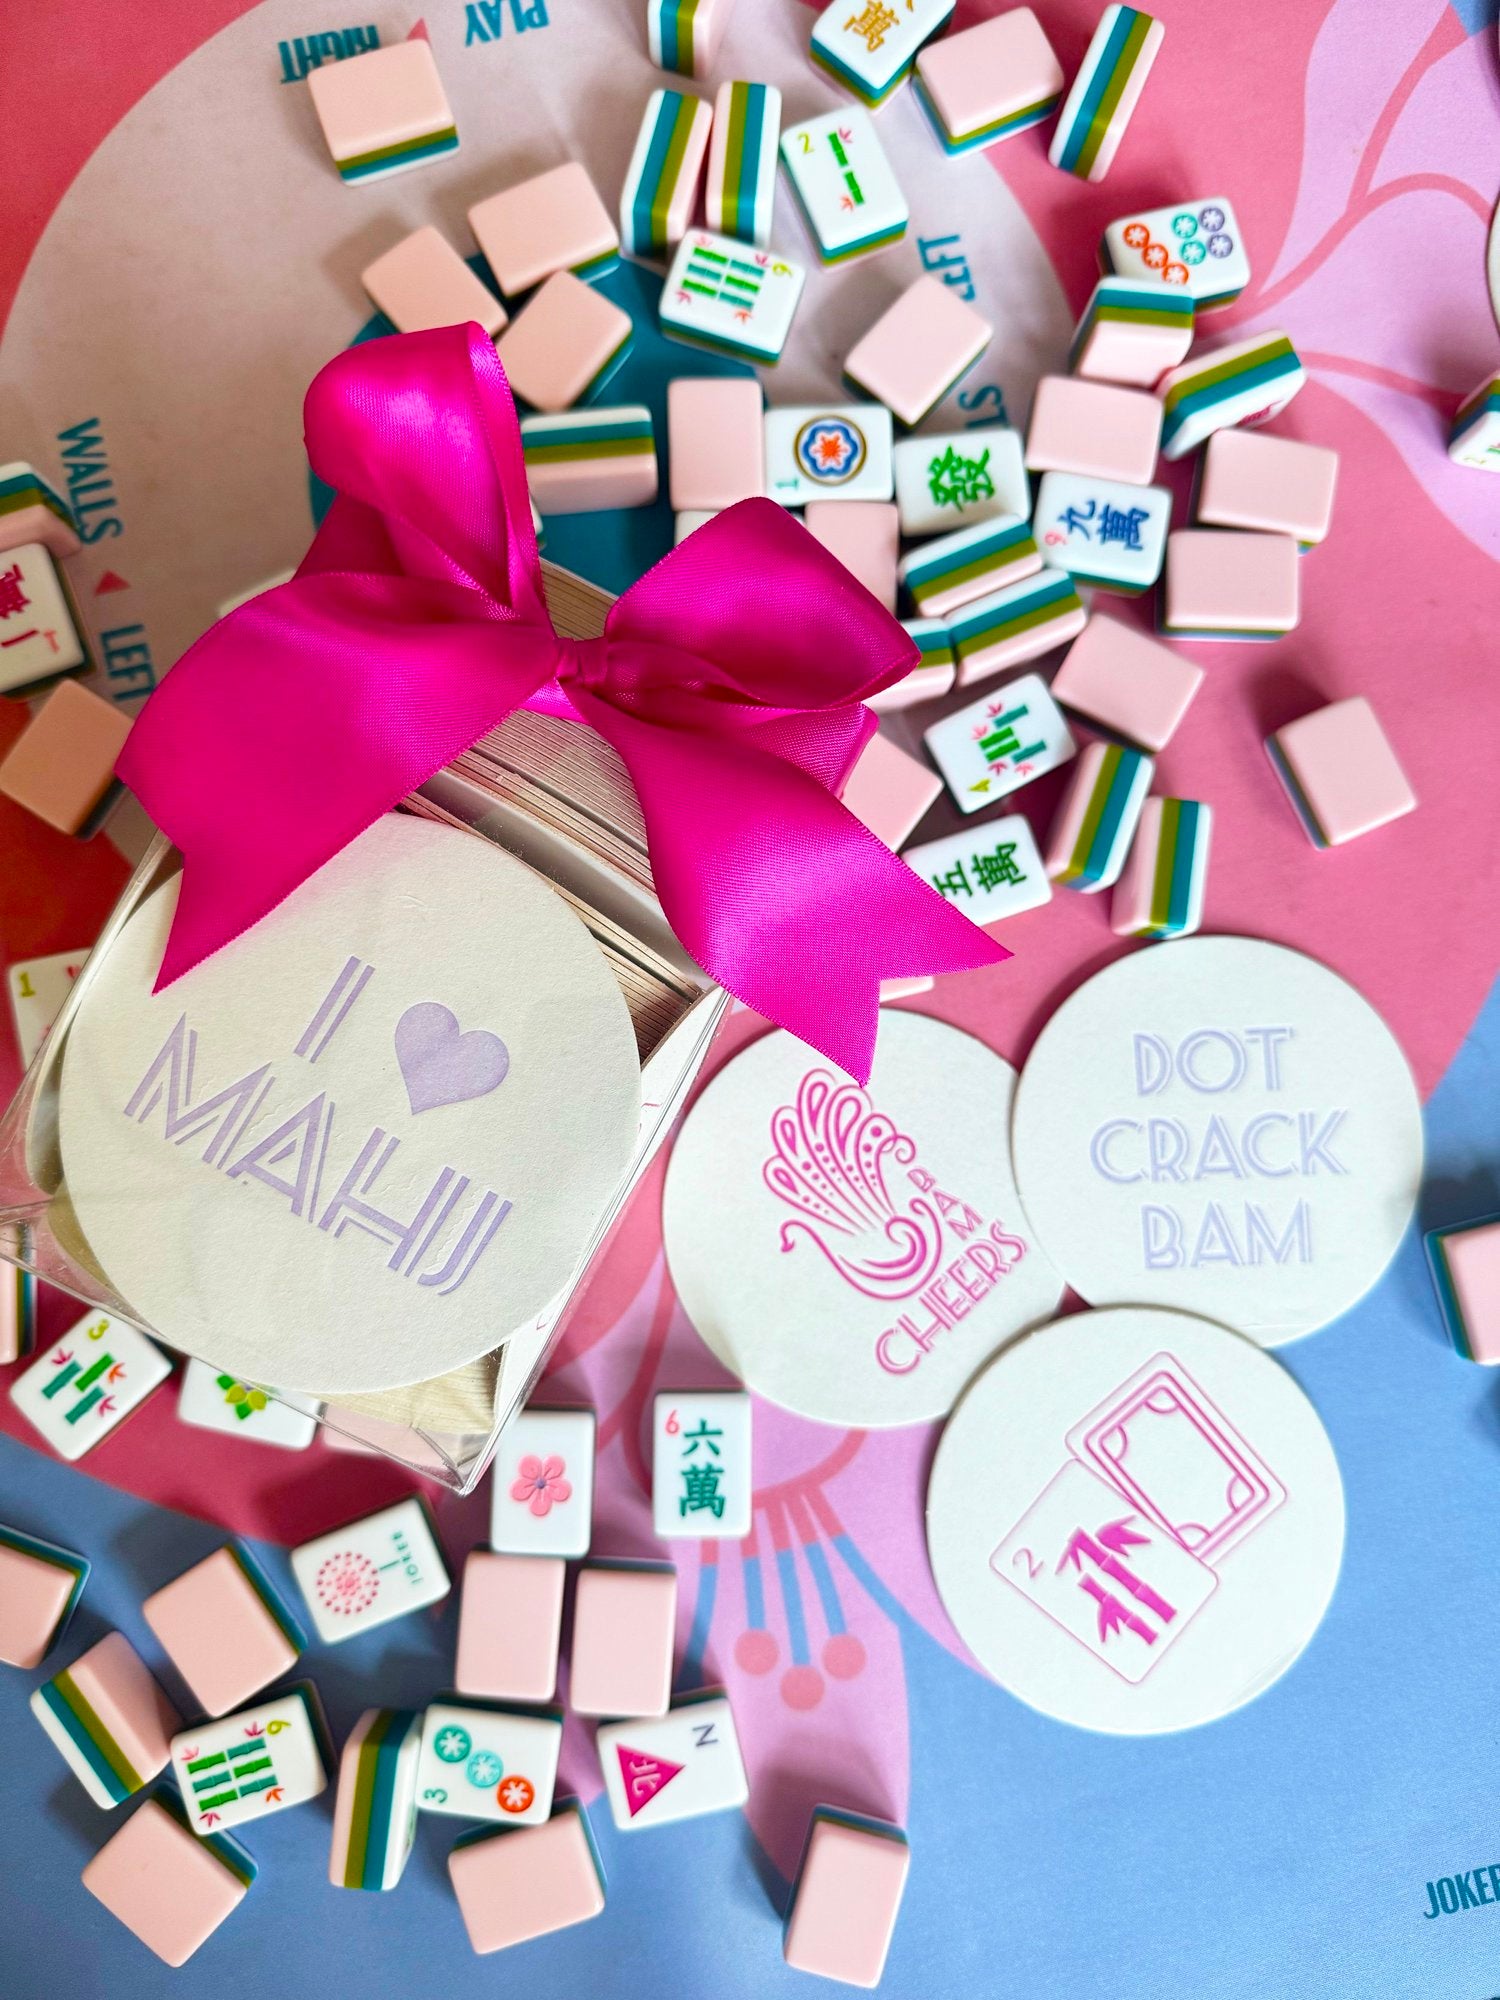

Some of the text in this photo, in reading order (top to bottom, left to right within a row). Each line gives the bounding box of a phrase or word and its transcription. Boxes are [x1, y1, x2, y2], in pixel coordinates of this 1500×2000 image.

[797, 132, 815, 154] 2
[57, 417, 123, 545] WALLS
[775, 477, 799, 491] 1
[928, 444, 995, 512] 發
[19, 970, 36, 998] 1
[293, 955, 376, 1064] I
[1133, 1026, 1295, 1097] DOT
[123, 1012, 513, 1296] MAHJ
[1089, 1107, 1349, 1185] CRACK
[907, 1168, 984, 1241] BAM
[1140, 1197, 1314, 1270] BAM
[876, 1218, 1028, 1375] CHEERS
[665, 1409, 679, 1435] 6
[680, 1418, 726, 1518] 六萬
[1012, 1547, 1045, 1579] 2
[424, 1788, 448, 1805] 3
